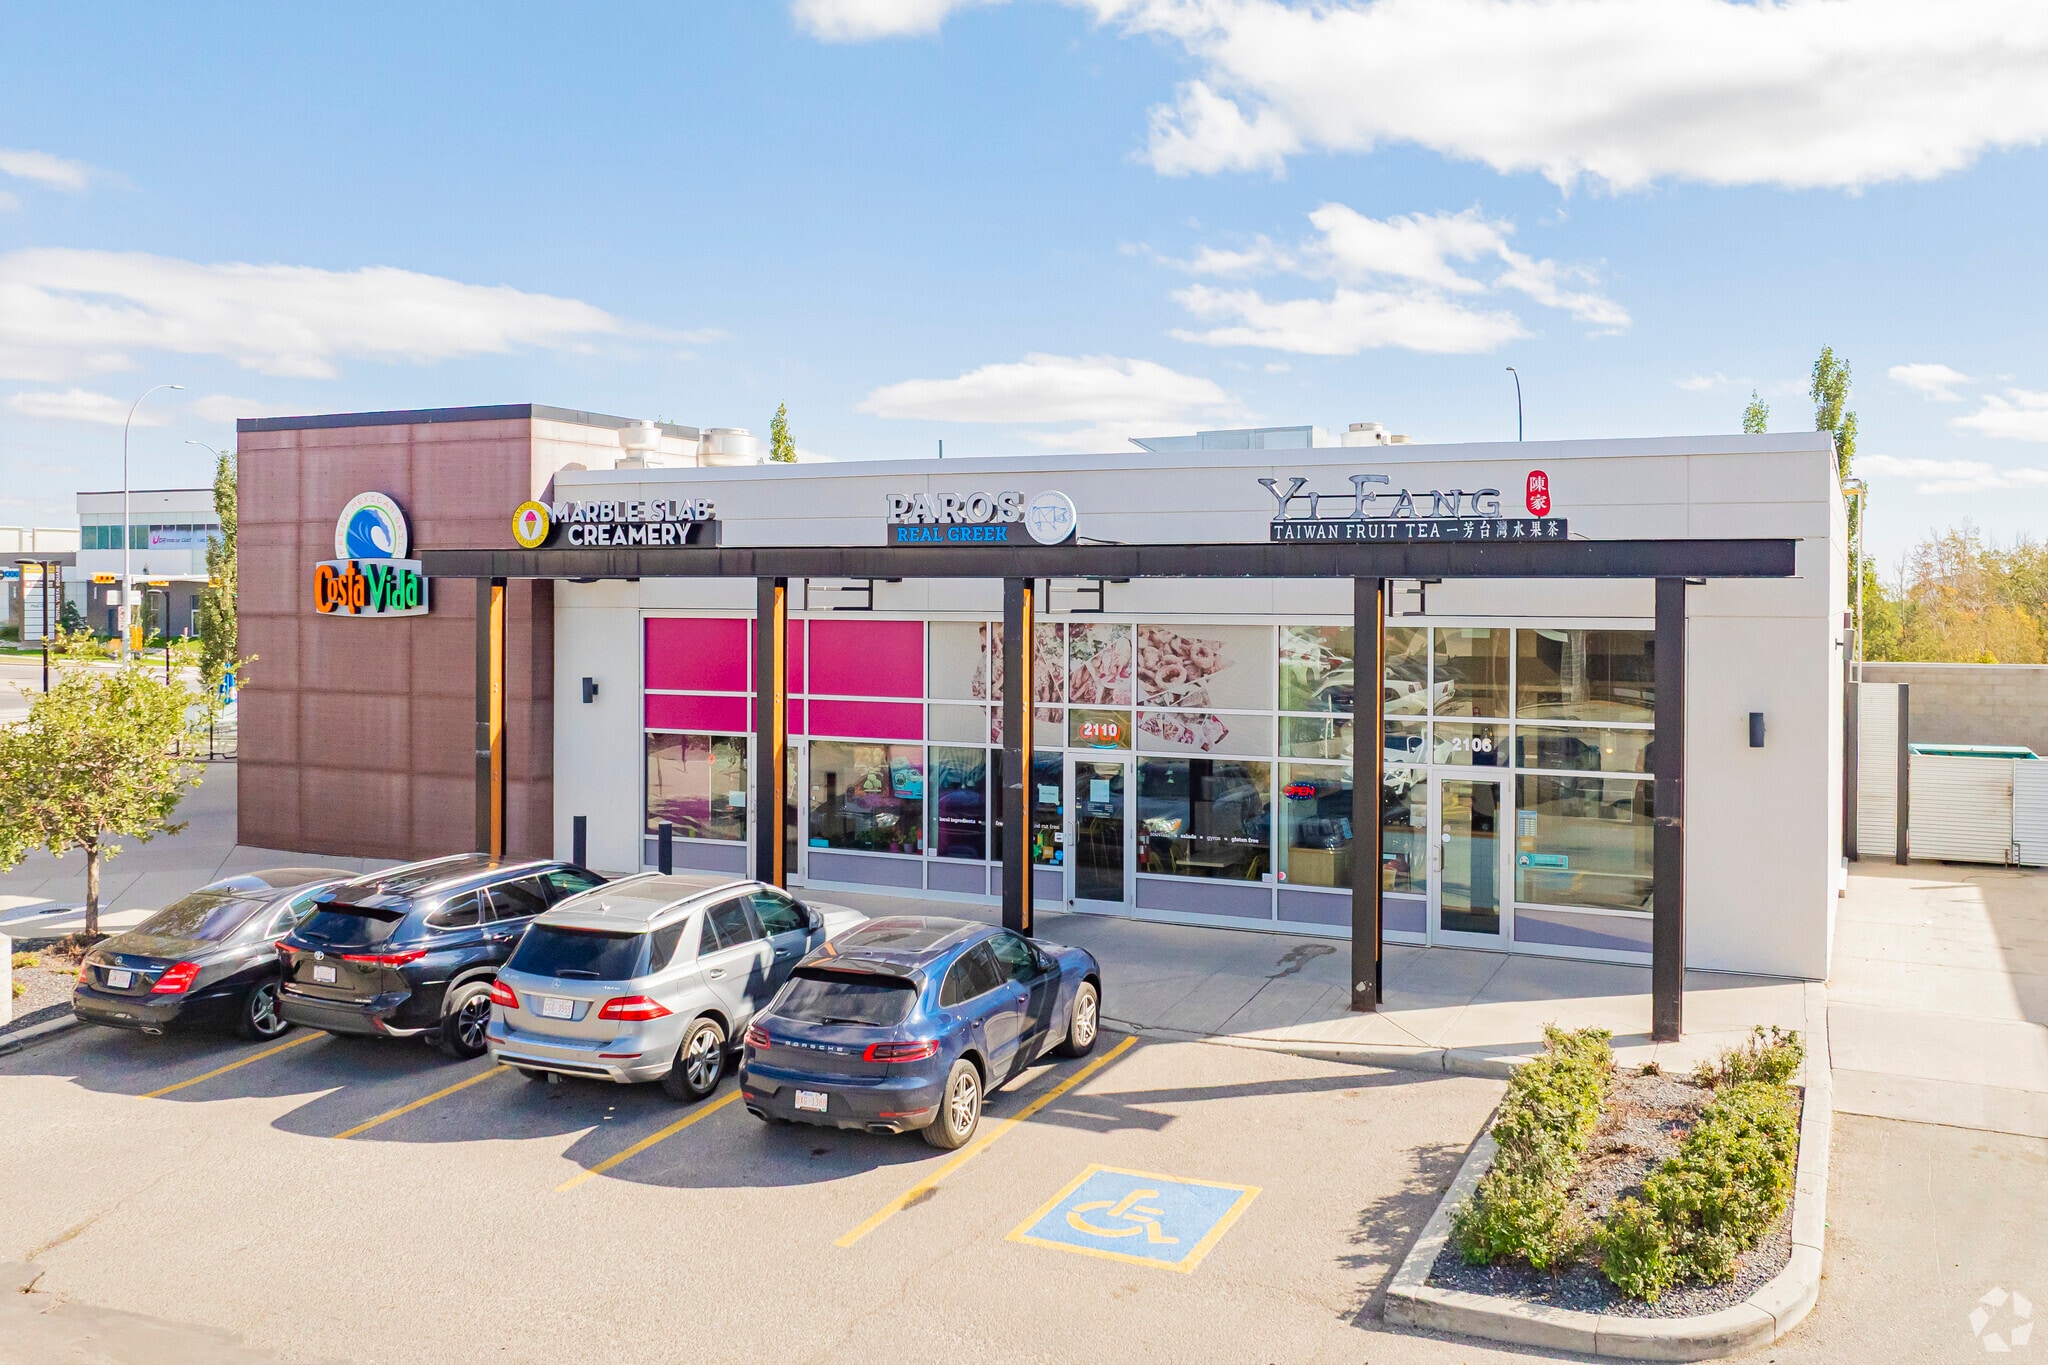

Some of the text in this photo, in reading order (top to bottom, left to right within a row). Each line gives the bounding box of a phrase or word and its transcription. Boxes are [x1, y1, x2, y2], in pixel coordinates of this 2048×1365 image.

[1529, 476, 1547, 511] 陳家
[551, 499, 711, 523] MARBLE SLAB
[886, 491, 1021, 524] PAROS
[567, 523, 691, 546] CREAMERY
[897, 526, 1007, 542] REAL GREEK
[1274, 523, 1440, 539] TAIWAN FRUIT TEA
[314, 560, 417, 614] Costa Vida
[1083, 722, 1118, 736] 2110
[1452, 737, 1492, 752] 2106
[1283, 784, 1315, 797] OPEN
[785, 1040, 843, 1052] PORSCHE
